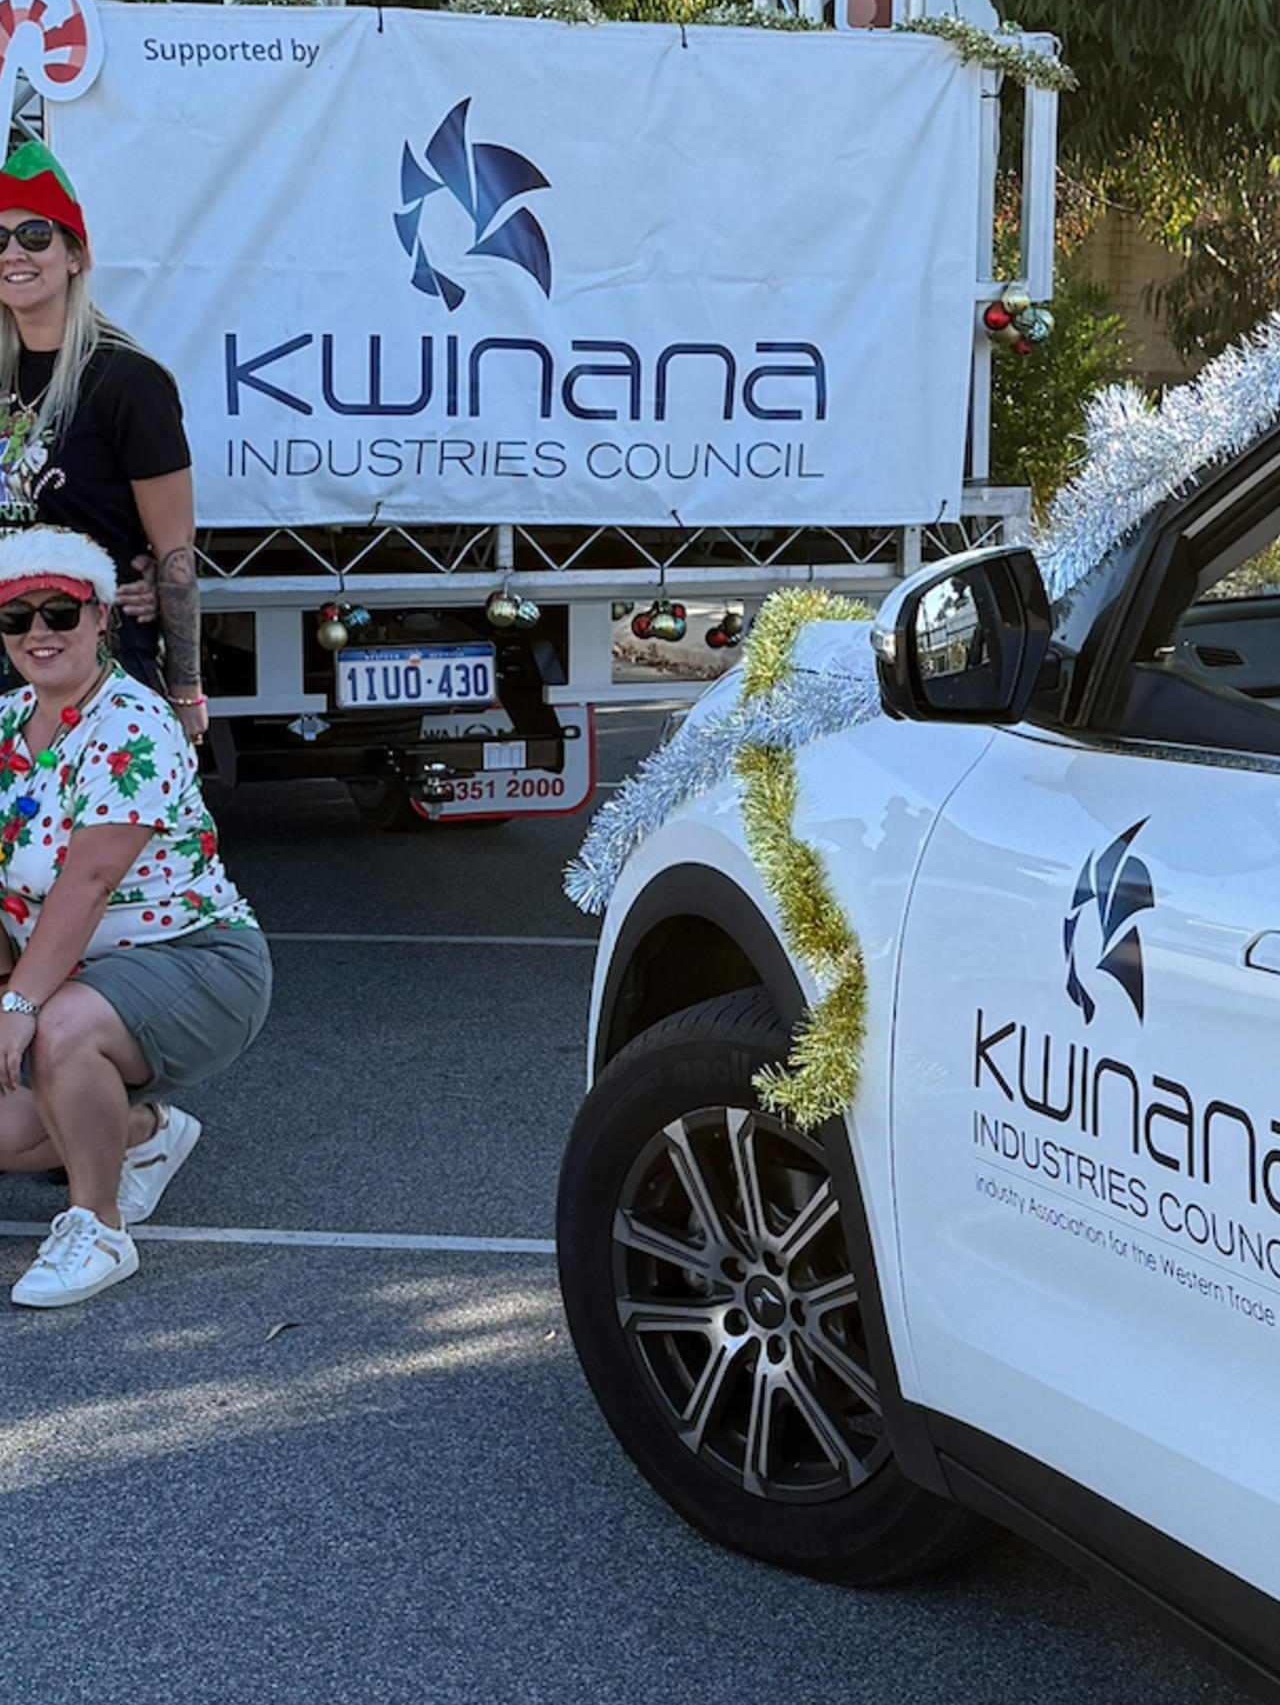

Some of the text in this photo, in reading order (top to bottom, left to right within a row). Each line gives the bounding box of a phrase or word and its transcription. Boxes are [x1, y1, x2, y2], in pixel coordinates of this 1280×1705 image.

[144, 37, 320, 69] Supported by
[226, 437, 824, 480] INDUSTRIES COUNCIL
[506, 778, 565, 798] 2000
[972, 1109, 1149, 1219] INDUSTRIES
[1028, 1196, 1107, 1248] Association
[1108, 1230, 1129, 1259] for
[1131, 1239, 1158, 1273] the
[1160, 1254, 1225, 1305] Western
[1226, 1284, 1276, 1328] Trade
